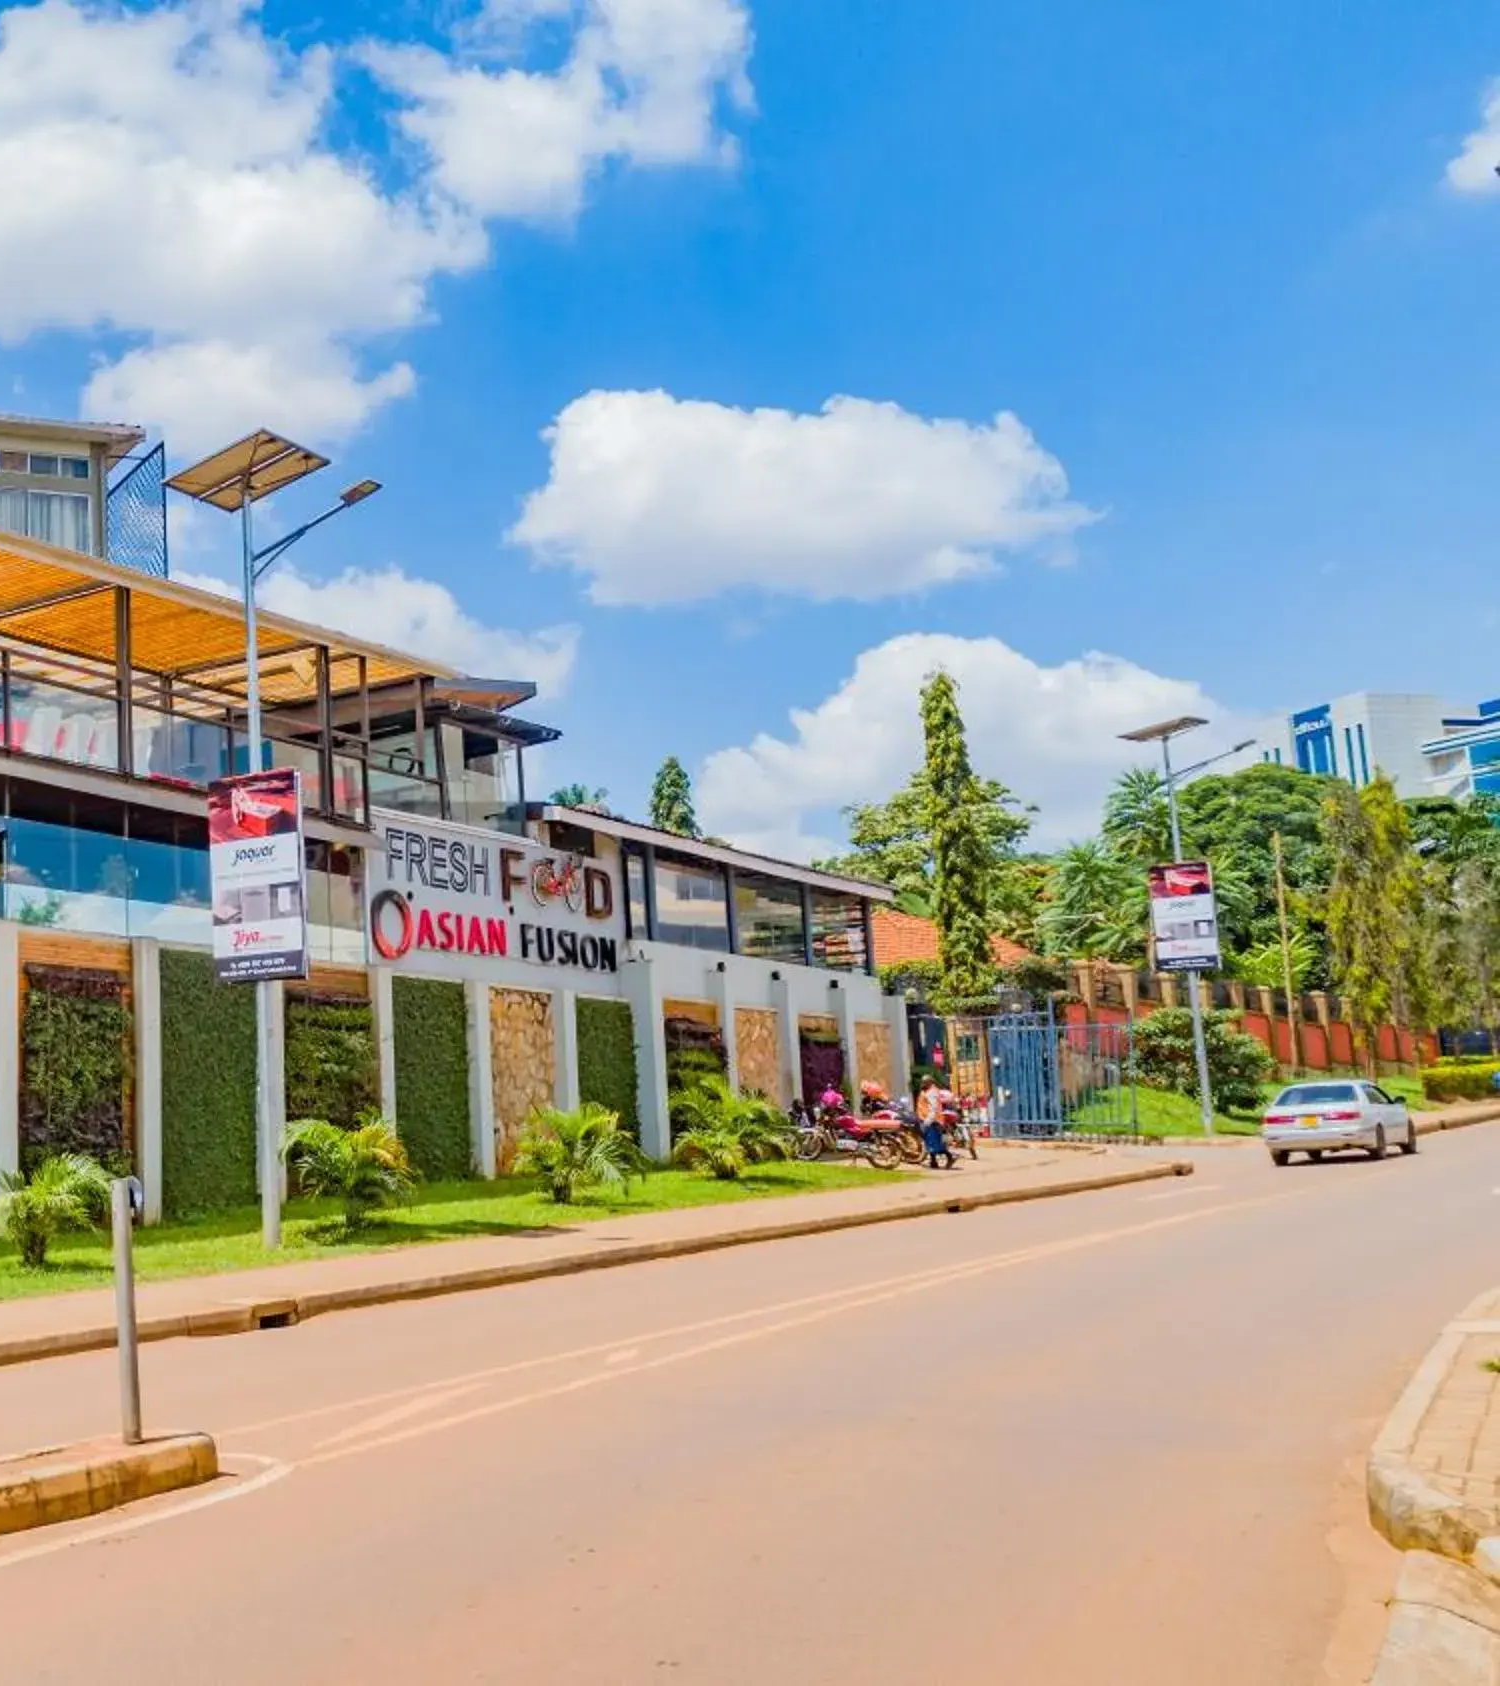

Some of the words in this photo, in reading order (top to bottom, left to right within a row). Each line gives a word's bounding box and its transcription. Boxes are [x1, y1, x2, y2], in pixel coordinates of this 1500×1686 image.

[385, 827, 491, 897] FRESH
[417, 908, 507, 958] ASIAN
[519, 923, 618, 973] FUSION
